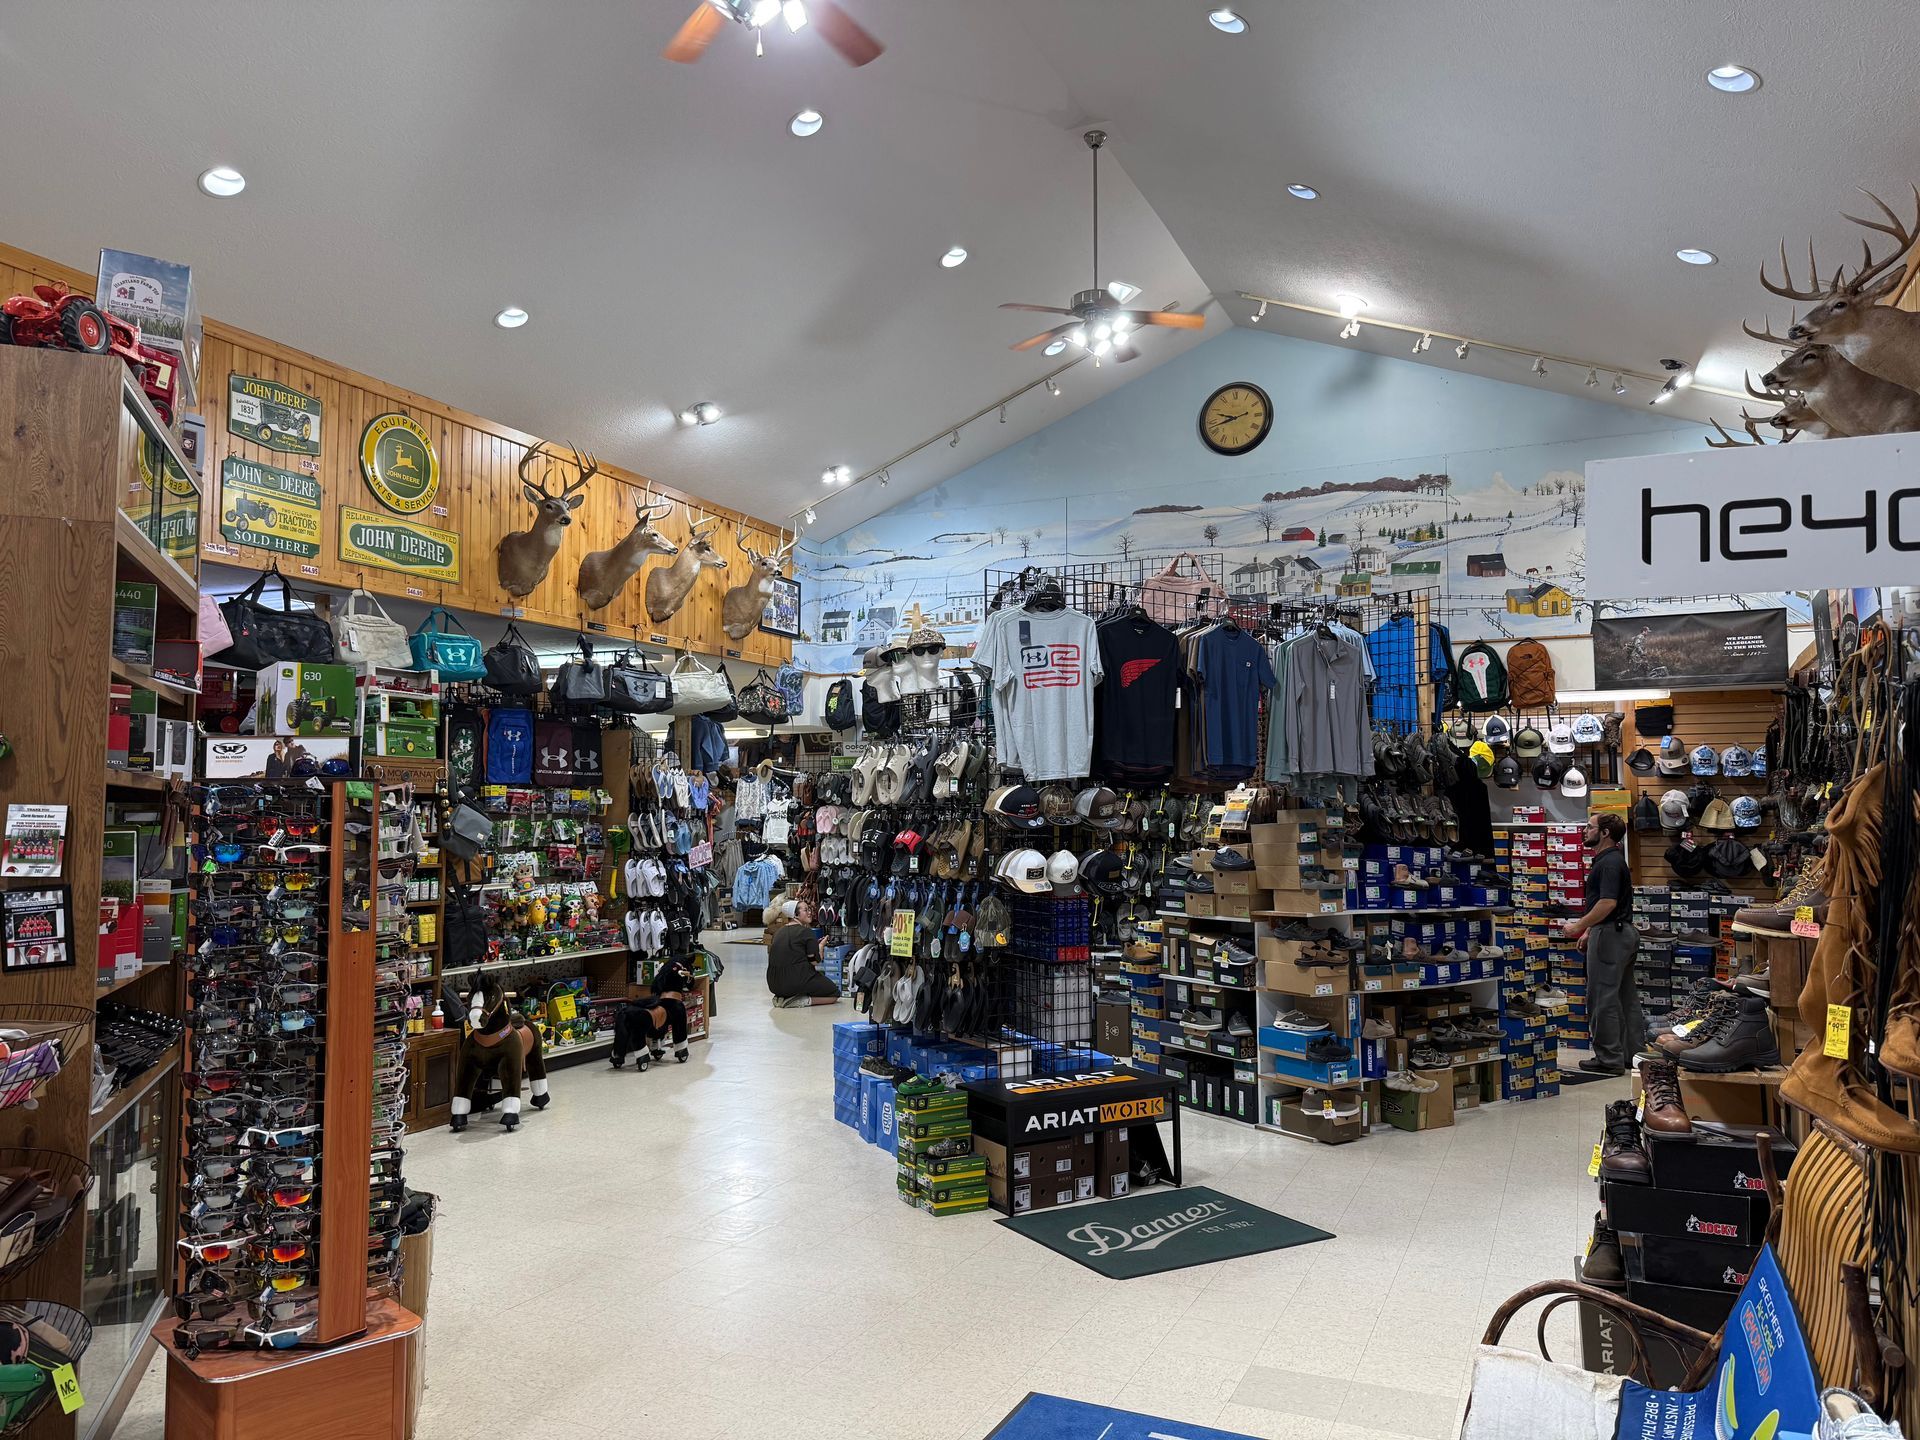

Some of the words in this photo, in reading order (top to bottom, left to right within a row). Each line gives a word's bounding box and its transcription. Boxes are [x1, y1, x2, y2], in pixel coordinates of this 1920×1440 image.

[243, 380, 272, 400] JOHN
[274, 390, 307, 410] DEERE
[374, 418, 432, 453] EQUIPMENT
[230, 462, 262, 484] JOHN
[280, 475, 316, 498] DEERE
[386, 469, 401, 480] JOHN
[402, 473, 420, 485] DEERE
[404, 486, 436, 510] SERVICE
[278, 512, 316, 530] TRACTORS
[346, 511, 379, 523] RELIABLE
[234, 530, 270, 546] SOLD
[276, 540, 308, 554] HERE
[357, 528, 395, 550] JOHN
[401, 534, 445, 564] DEERE
[429, 530, 457, 544] TRUSTED
[345, 548, 378, 562] DEPENDABLE
[304, 671, 321, 681] 630
[1005, 1070, 1116, 1091] ARIAT
[1024, 1107, 1098, 1132] ARIAT
[1102, 1098, 1163, 1120] WORK
[1747, 1179, 1767, 1191] ROC
[1067, 1201, 1227, 1257] Danner
[1700, 1222, 1737, 1237] ROCKY
[1758, 1277, 1784, 1348] SKECHERS
[1599, 1314, 1614, 1375] ARIAT
[1743, 1307, 1762, 1352] MEMORY
[1758, 1350, 1771, 1385] FOAM
[60, 1379, 76, 1397] MC
